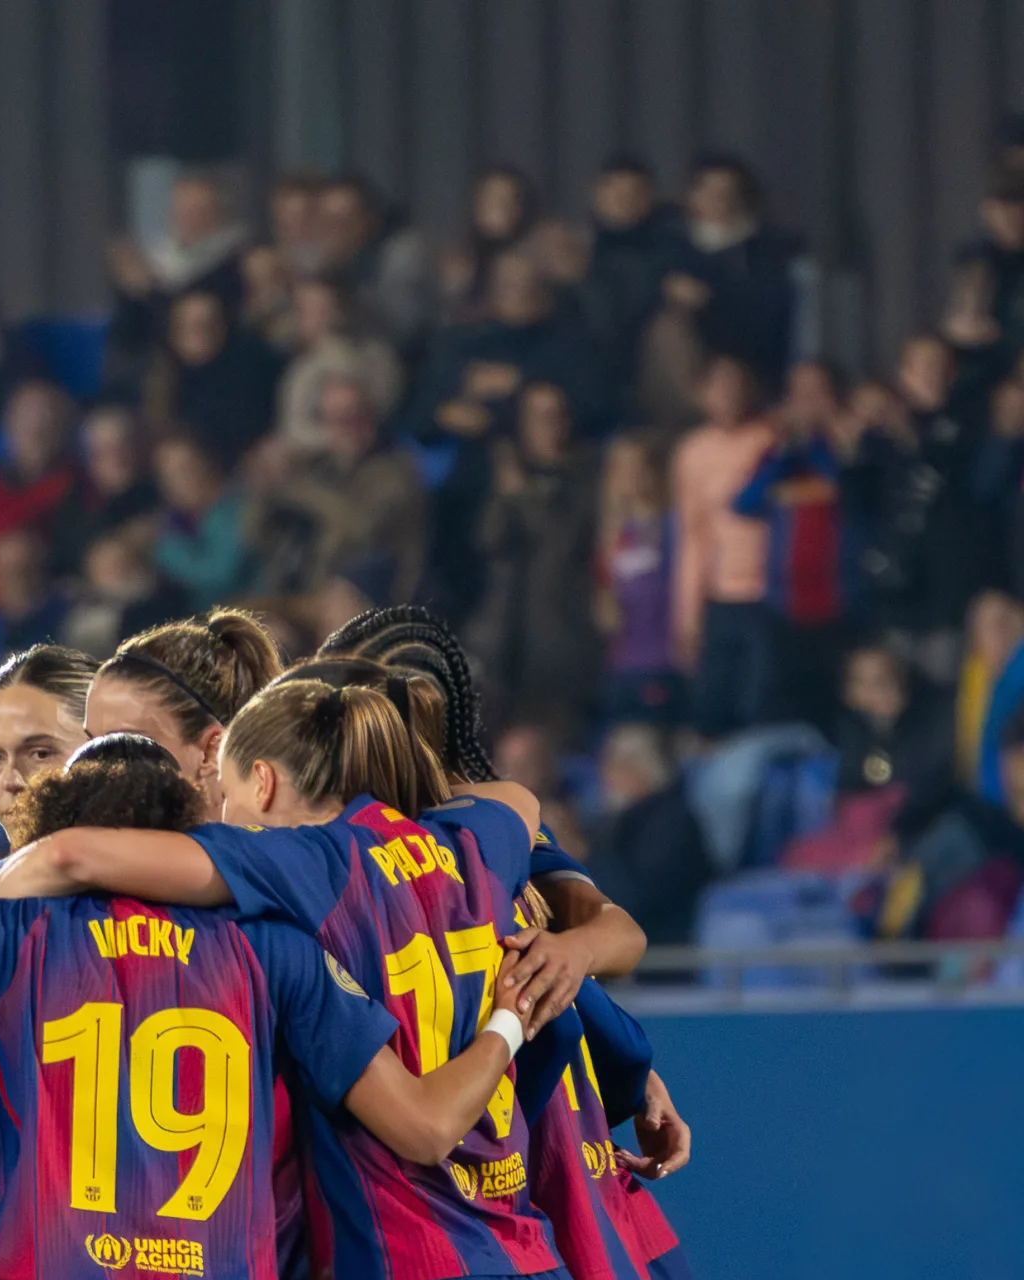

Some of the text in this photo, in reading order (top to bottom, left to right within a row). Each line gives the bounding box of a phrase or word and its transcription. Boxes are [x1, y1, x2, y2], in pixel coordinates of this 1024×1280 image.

[88, 915, 195, 965] VICKY
[385, 922, 516, 1140] 17
[42, 1002, 250, 1221] 19
[481, 1152, 523, 1176] UNHCR
[481, 1166, 527, 1193] ACNUR
[134, 1238, 203, 1256] UNHCR
[135, 1252, 204, 1271] ACNUR
